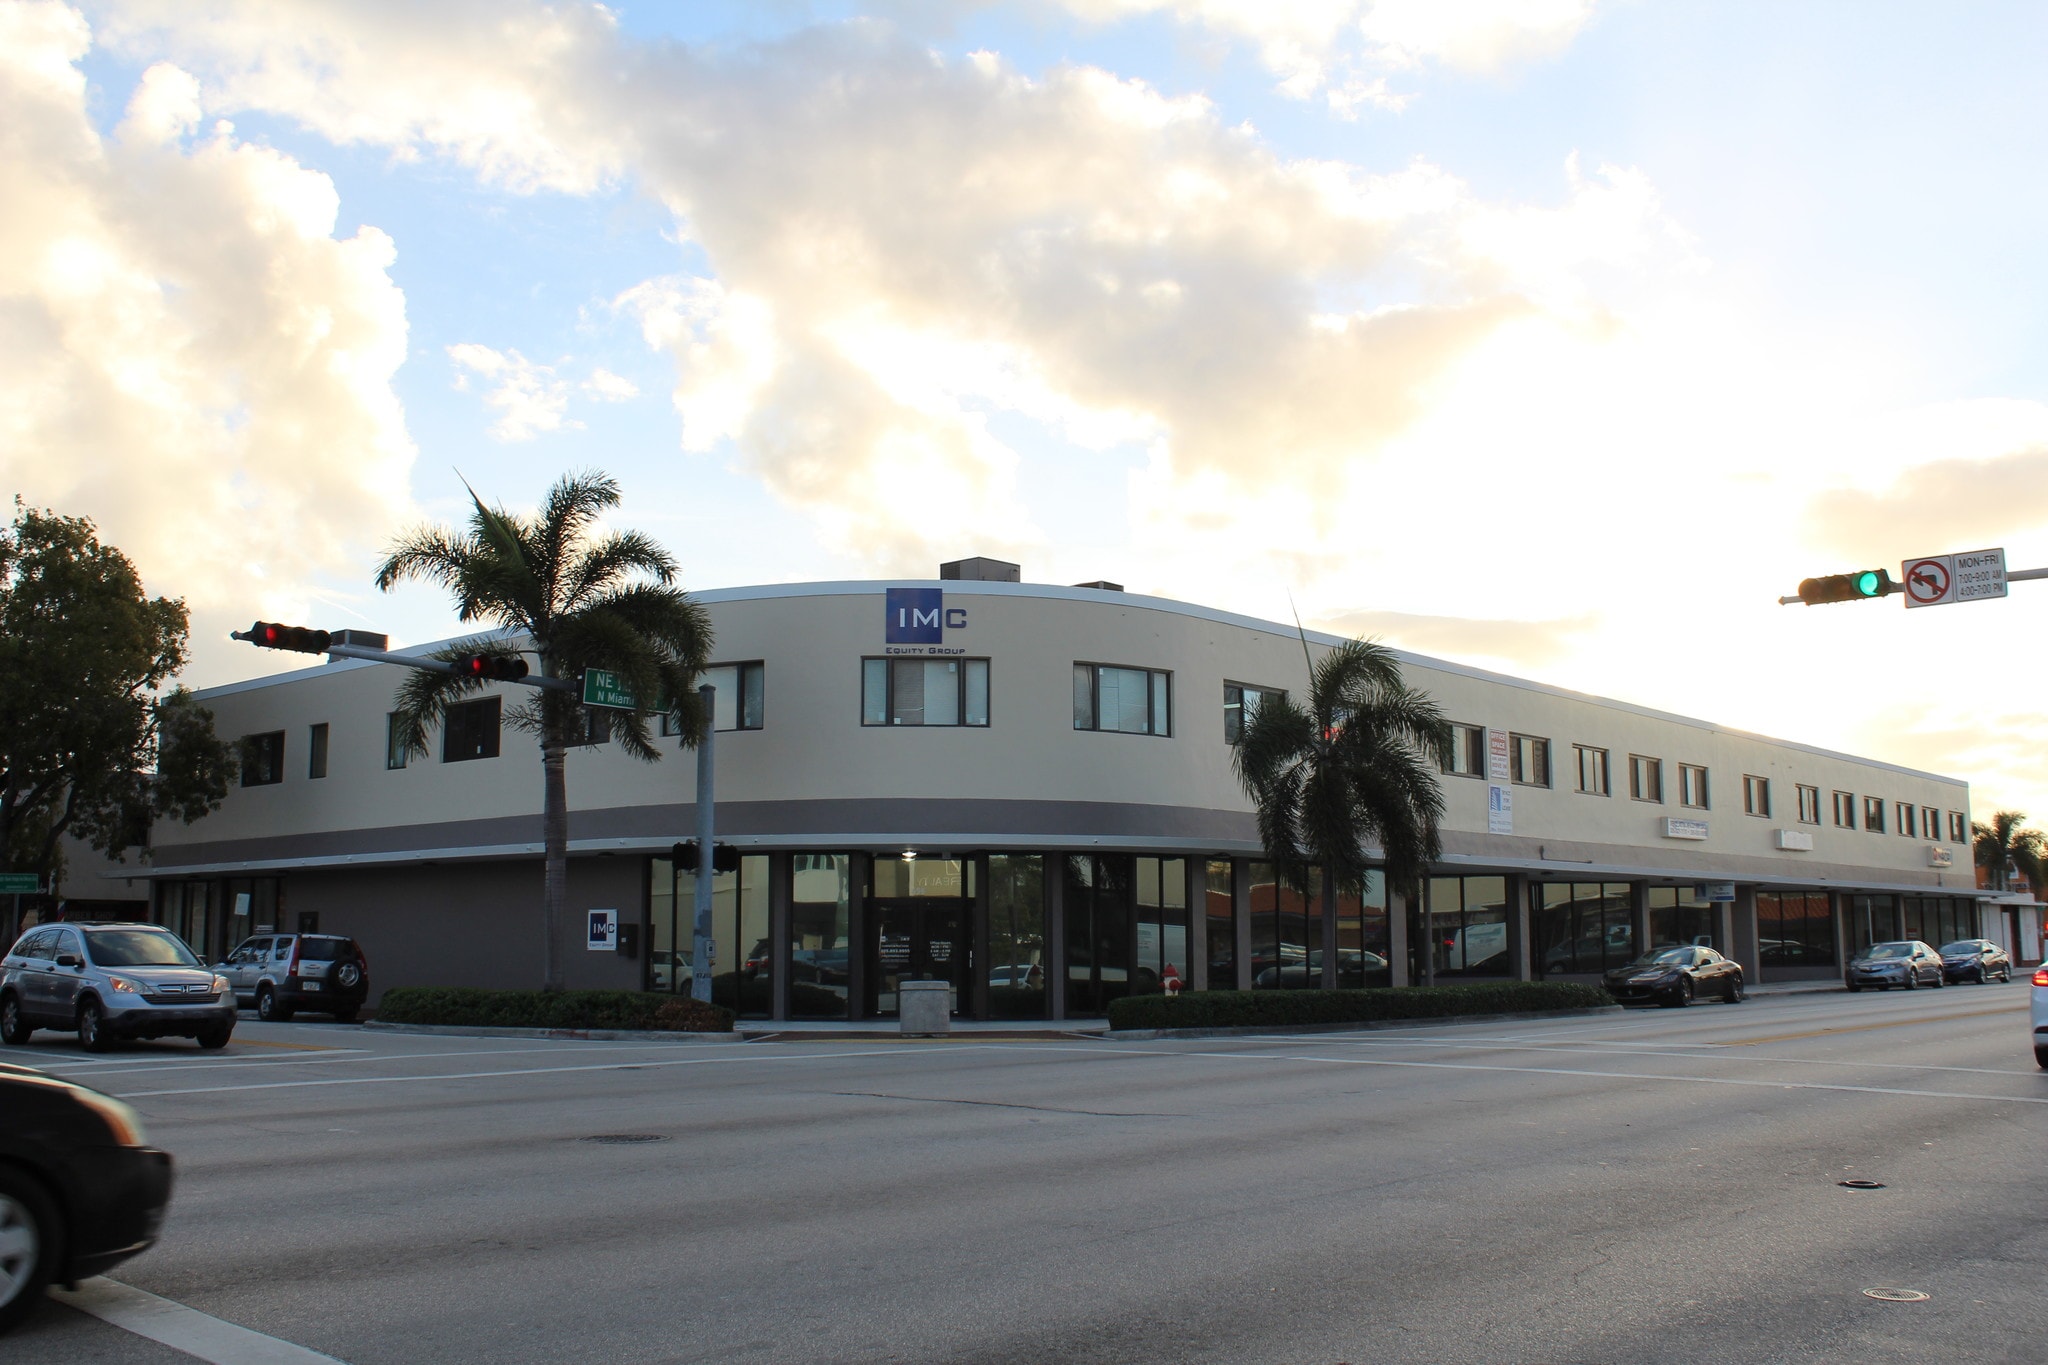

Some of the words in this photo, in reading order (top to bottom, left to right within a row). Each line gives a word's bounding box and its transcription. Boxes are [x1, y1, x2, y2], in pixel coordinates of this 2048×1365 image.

[1958, 554, 1999, 569] MON-FRI
[1958, 571, 1990, 584] 7:00-9:00
[1992, 569, 2003, 580] AM
[1960, 583, 1991, 597] 4:00-7:00
[1993, 582, 2004, 593] PM
[899, 607, 967, 629] IMC
[885, 647, 924, 655] EQUITY
[928, 647, 966, 655] GROUP
[596, 672, 613, 688] NE
[597, 690, 604, 702] N
[593, 923, 615, 934] IMC
